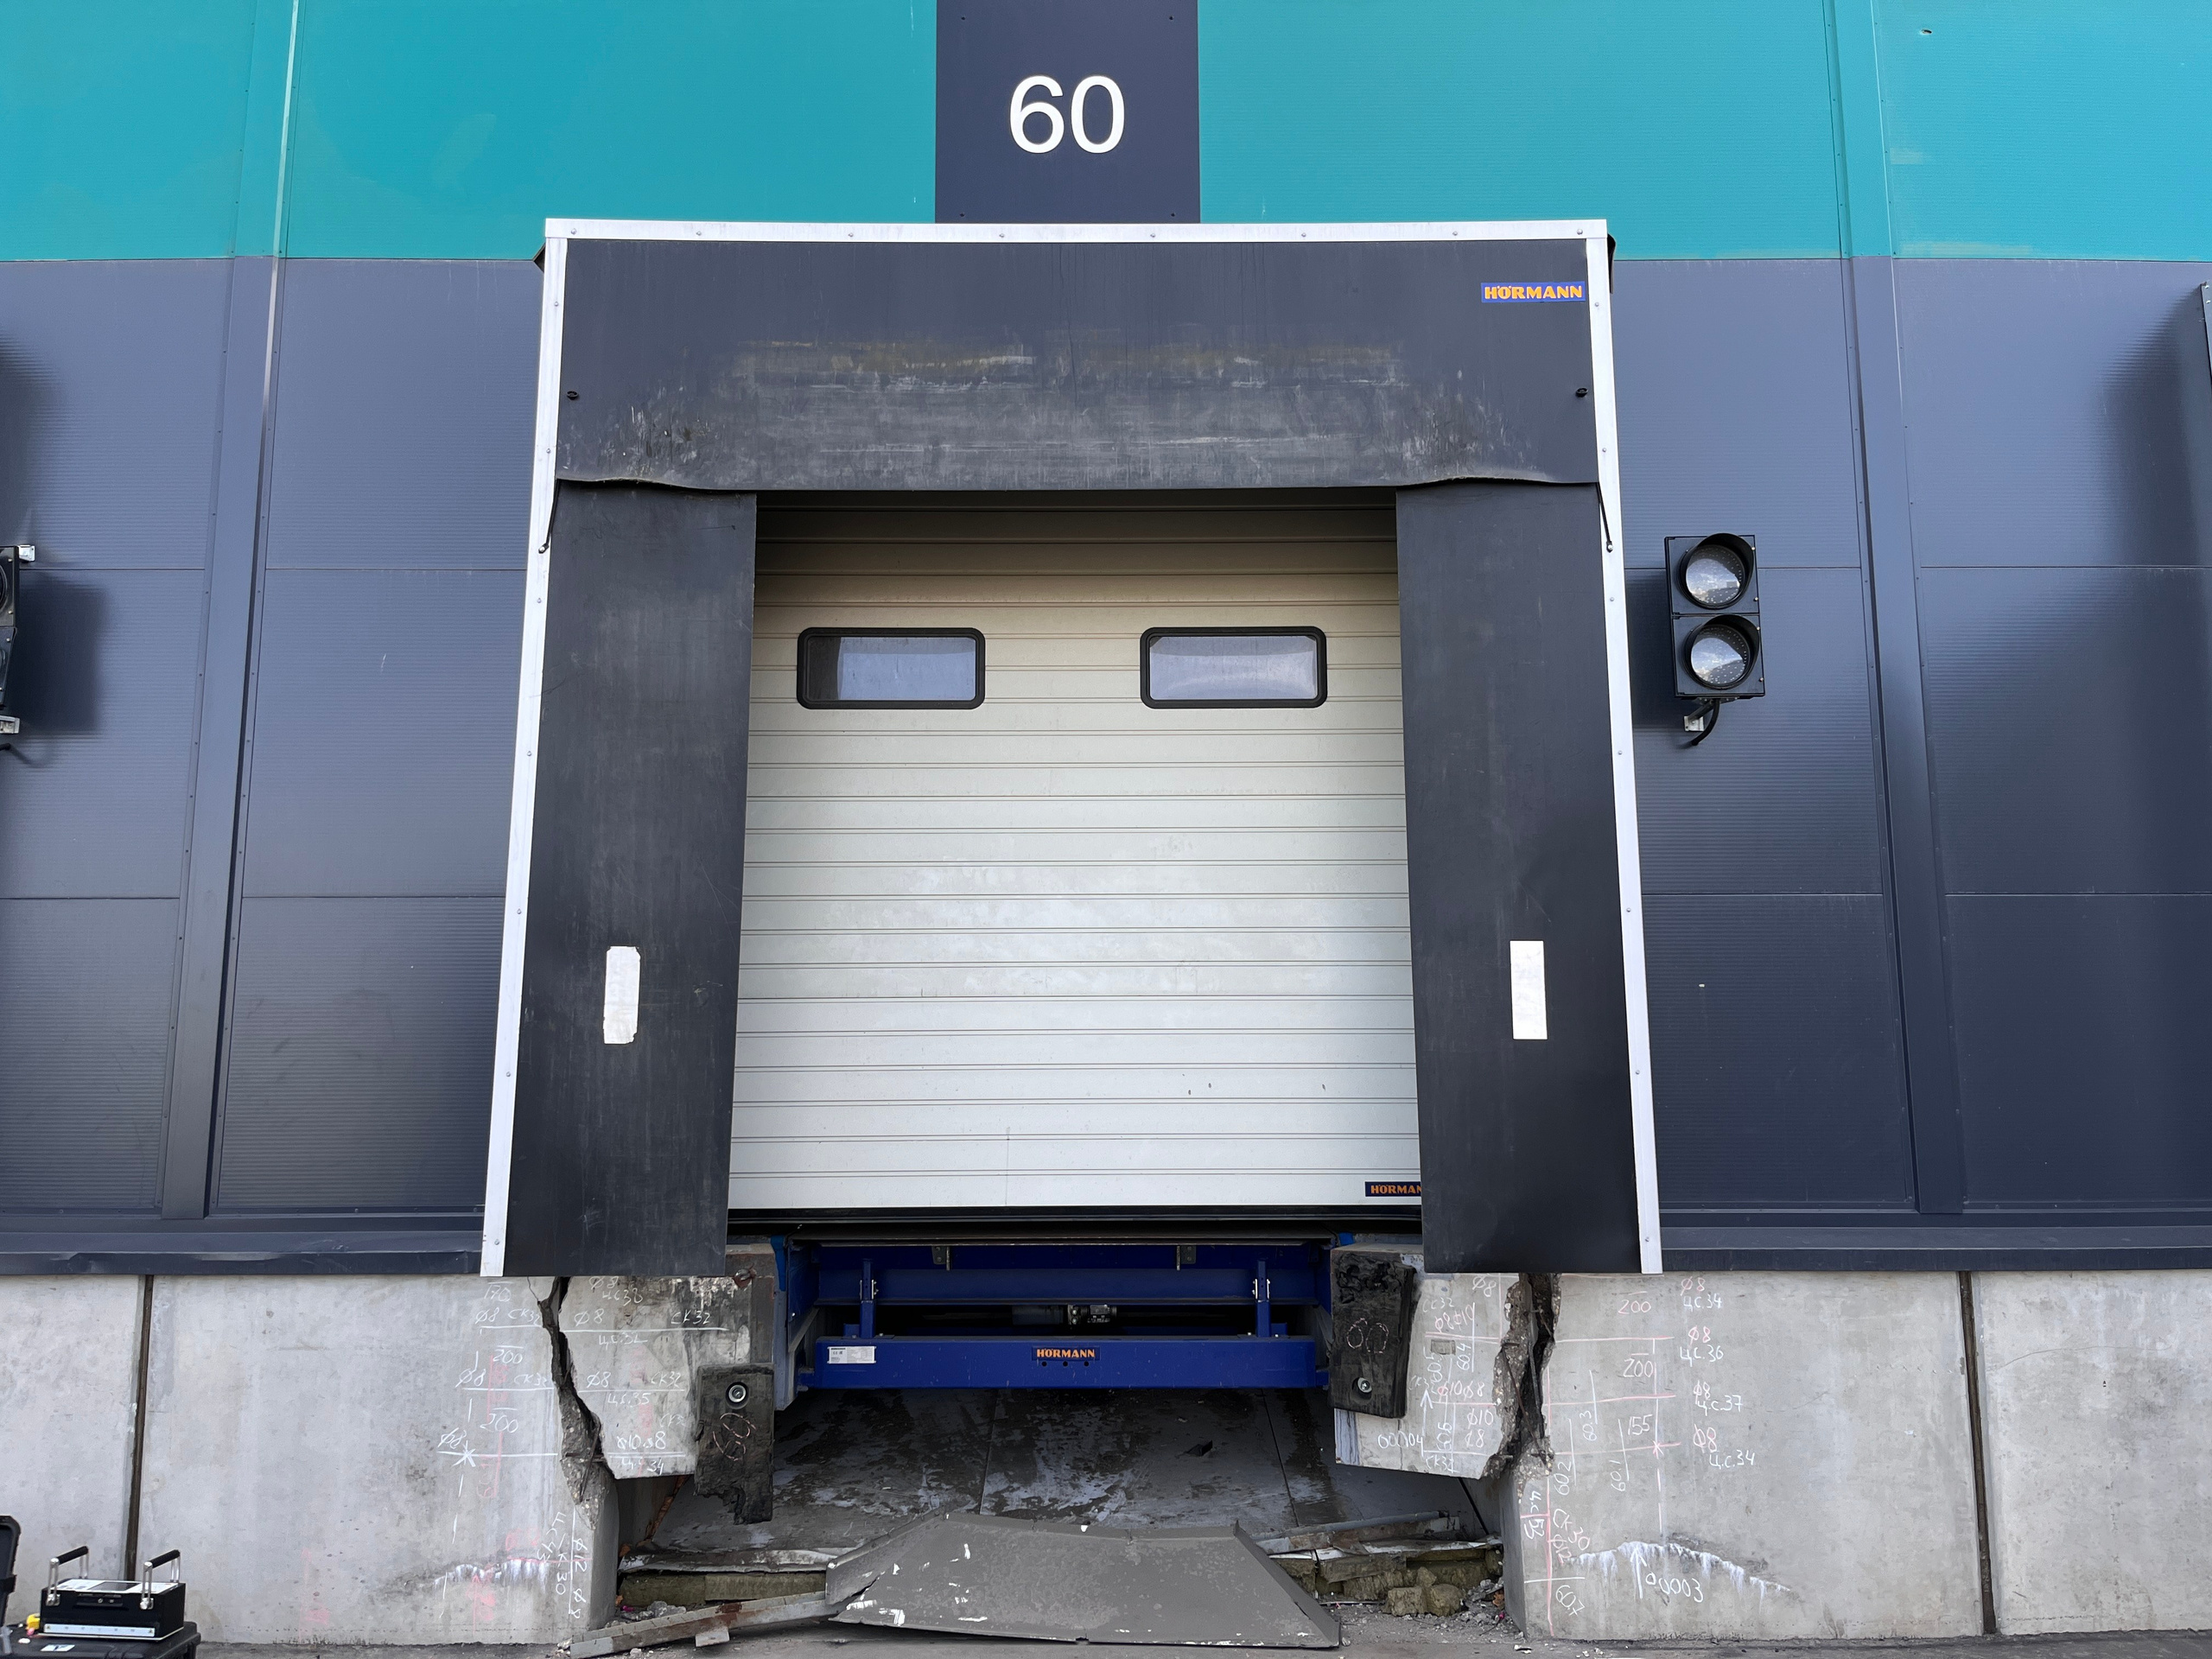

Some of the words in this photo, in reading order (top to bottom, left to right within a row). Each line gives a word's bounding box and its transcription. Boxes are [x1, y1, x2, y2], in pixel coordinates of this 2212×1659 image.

[1009, 74, 1125, 154] 60
[1484, 285, 1583, 299] HÖRMANN
[1618, 1299, 1652, 1314] 200
[1037, 1349, 1095, 1357] HÖRMANN
[1624, 1358, 1654, 1377] 200
[1628, 1414, 1652, 1436] 155
